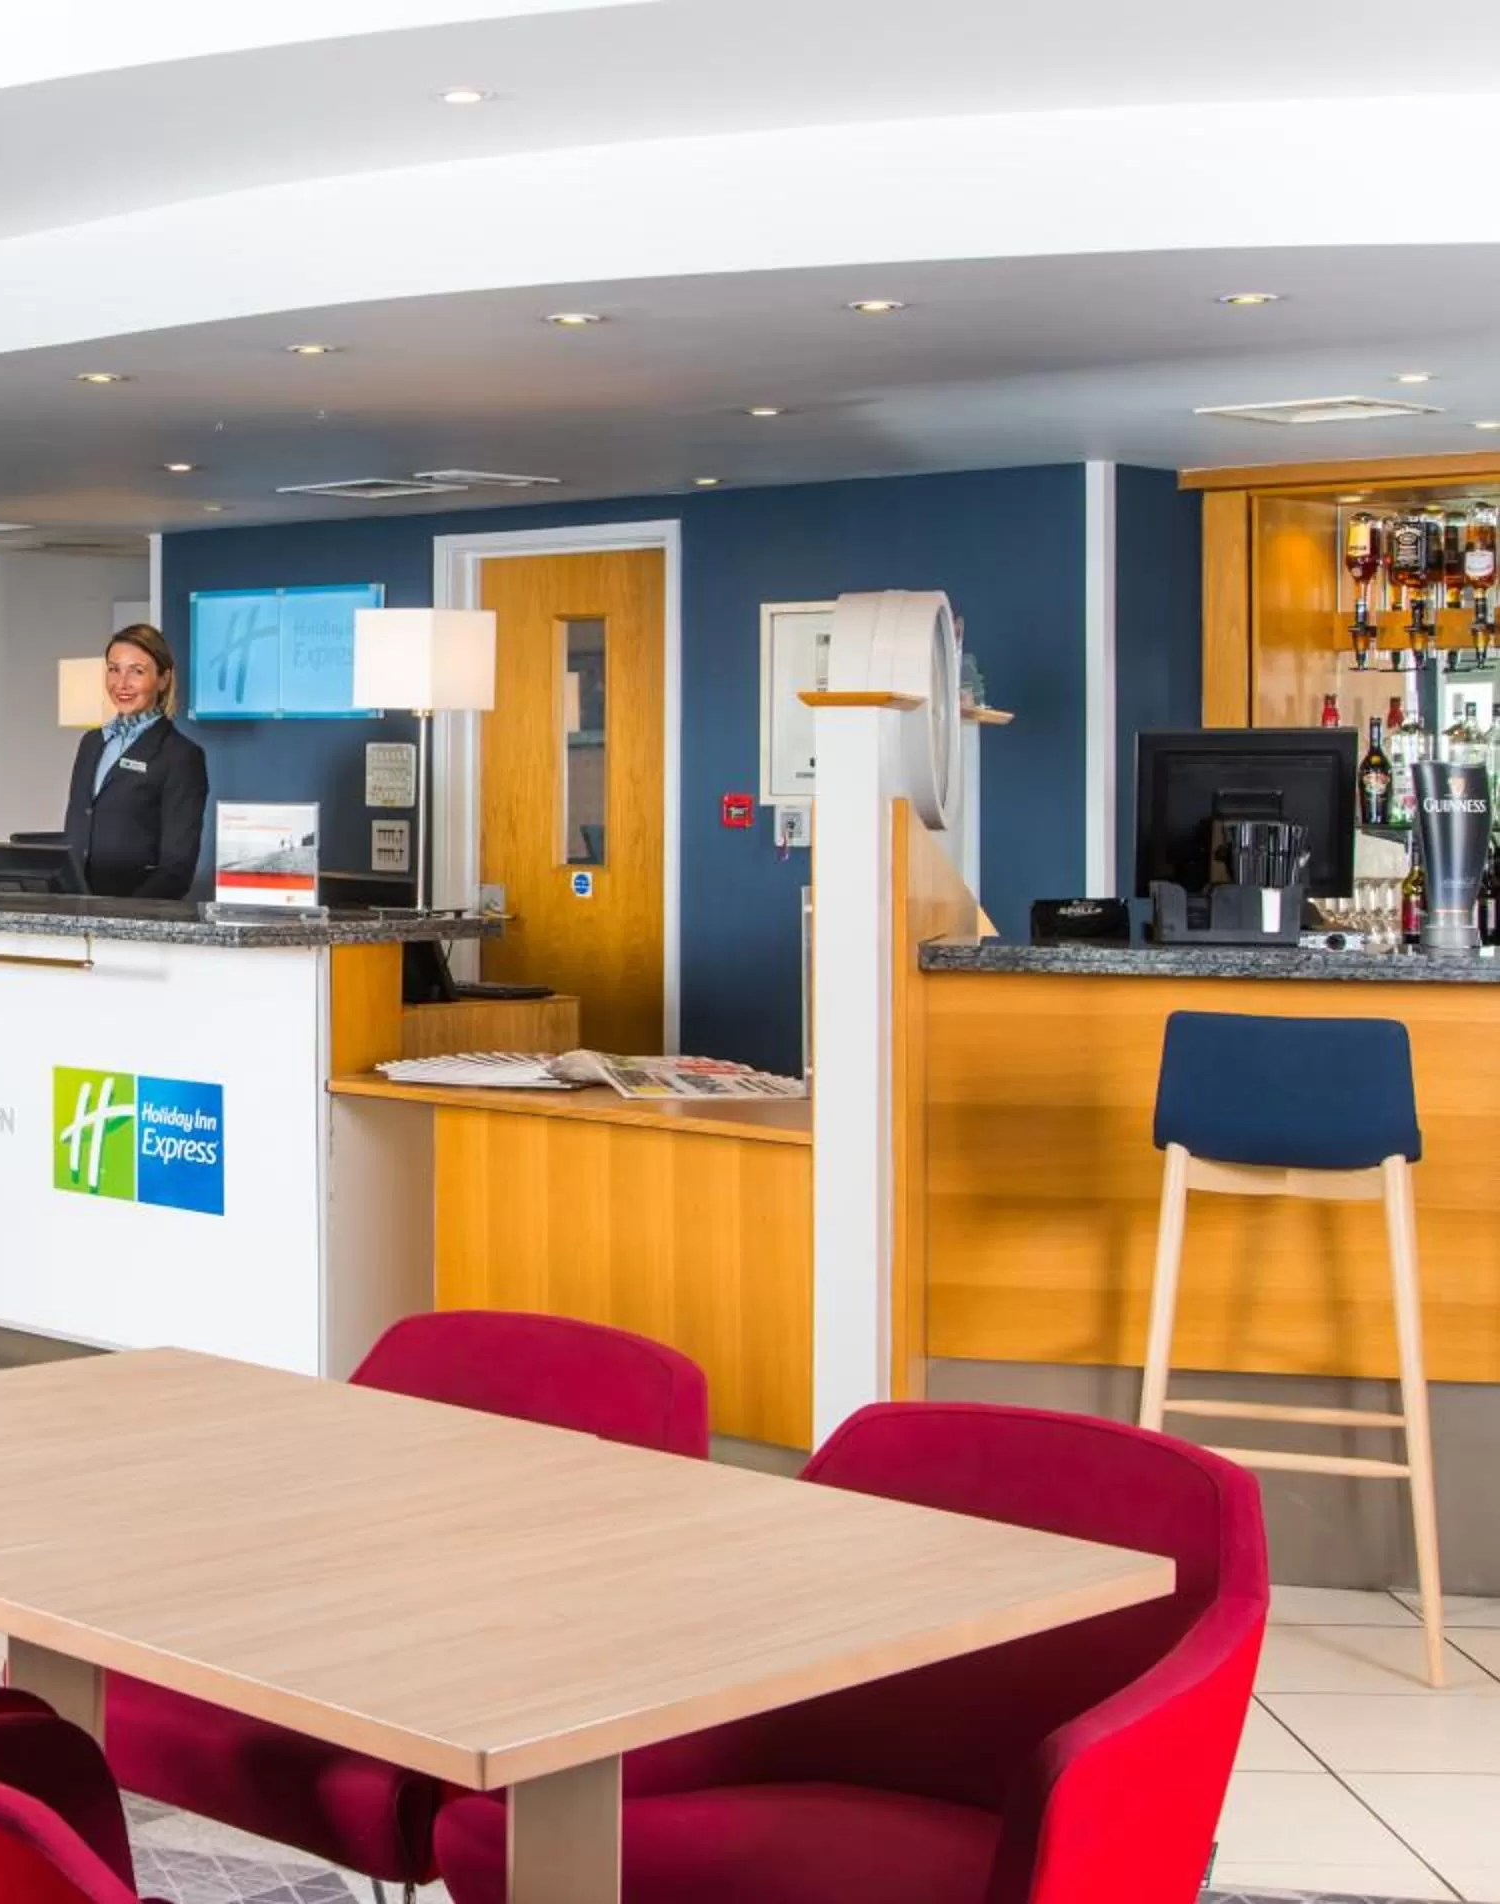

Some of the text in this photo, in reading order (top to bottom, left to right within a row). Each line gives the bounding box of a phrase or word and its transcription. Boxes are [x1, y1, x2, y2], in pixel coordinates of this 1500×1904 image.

[1423, 797, 1486, 813] GUINNESS
[141, 1101, 217, 1132] Holiday Inn
[141, 1128, 218, 1165] Express
